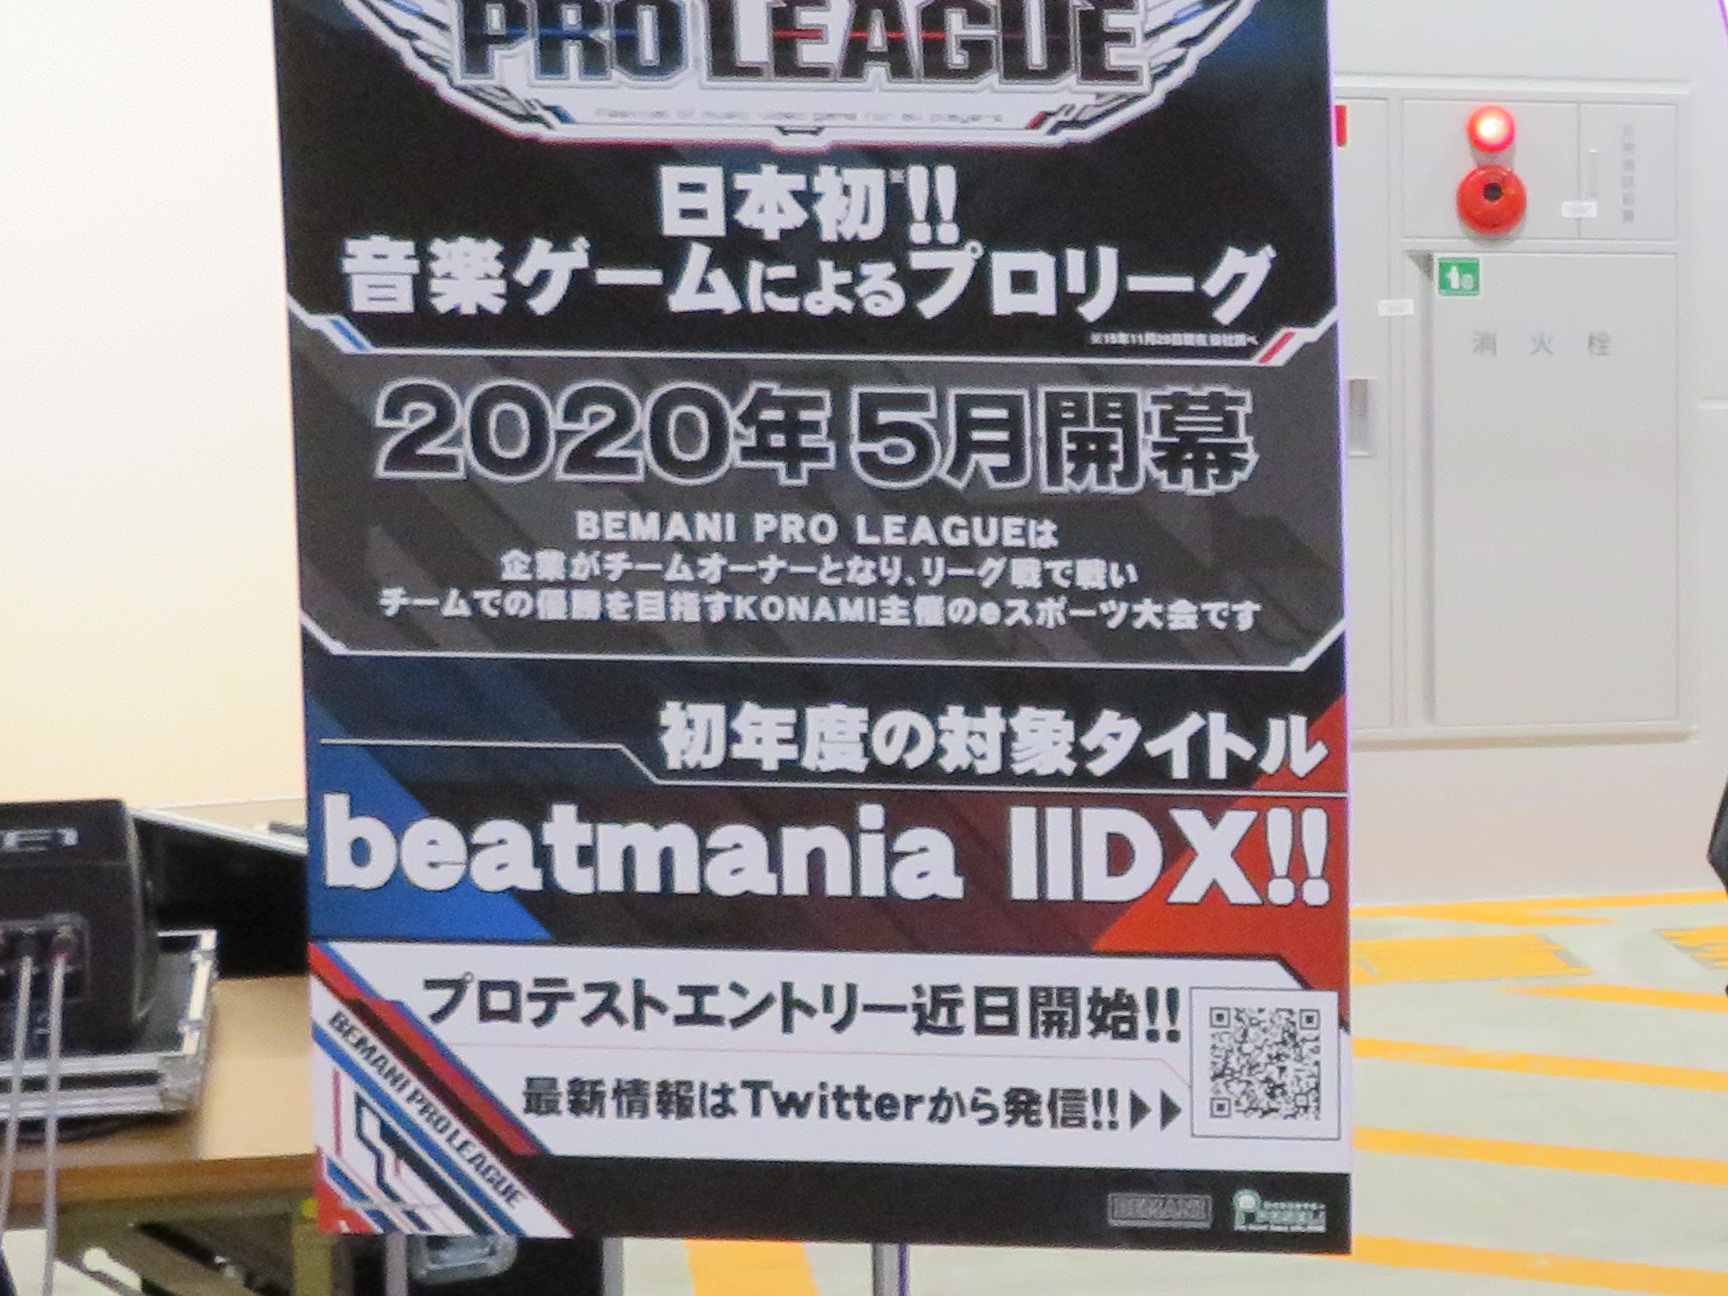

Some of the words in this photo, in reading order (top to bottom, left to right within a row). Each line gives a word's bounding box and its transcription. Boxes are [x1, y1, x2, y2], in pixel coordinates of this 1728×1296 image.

[341, 234, 1277, 326] 音楽ゲームによるプロリーグ
[374, 376, 1261, 496] 2020年5月開幕
[574, 509, 736, 544] BEMANI
[752, 512, 839, 546] PRO
[854, 512, 1059, 549] LEAGUEは
[500, 549, 1139, 591] 企業がチームオーナーとなり、リーグ戦で戦い
[660, 702, 1328, 780] 初年度の対象タイトル
[323, 793, 965, 901] beatmania
[1009, 806, 1330, 907] IIDX!!
[421, 972, 1182, 1044] プロテストエントリー近日開始!!
[328, 1010, 409, 1090] BEMANI
[404, 1088, 452, 1135] PRO
[446, 1130, 529, 1210] LEAGUE
[521, 1076, 1119, 1131] 最新情報はTwitterから発信!!
